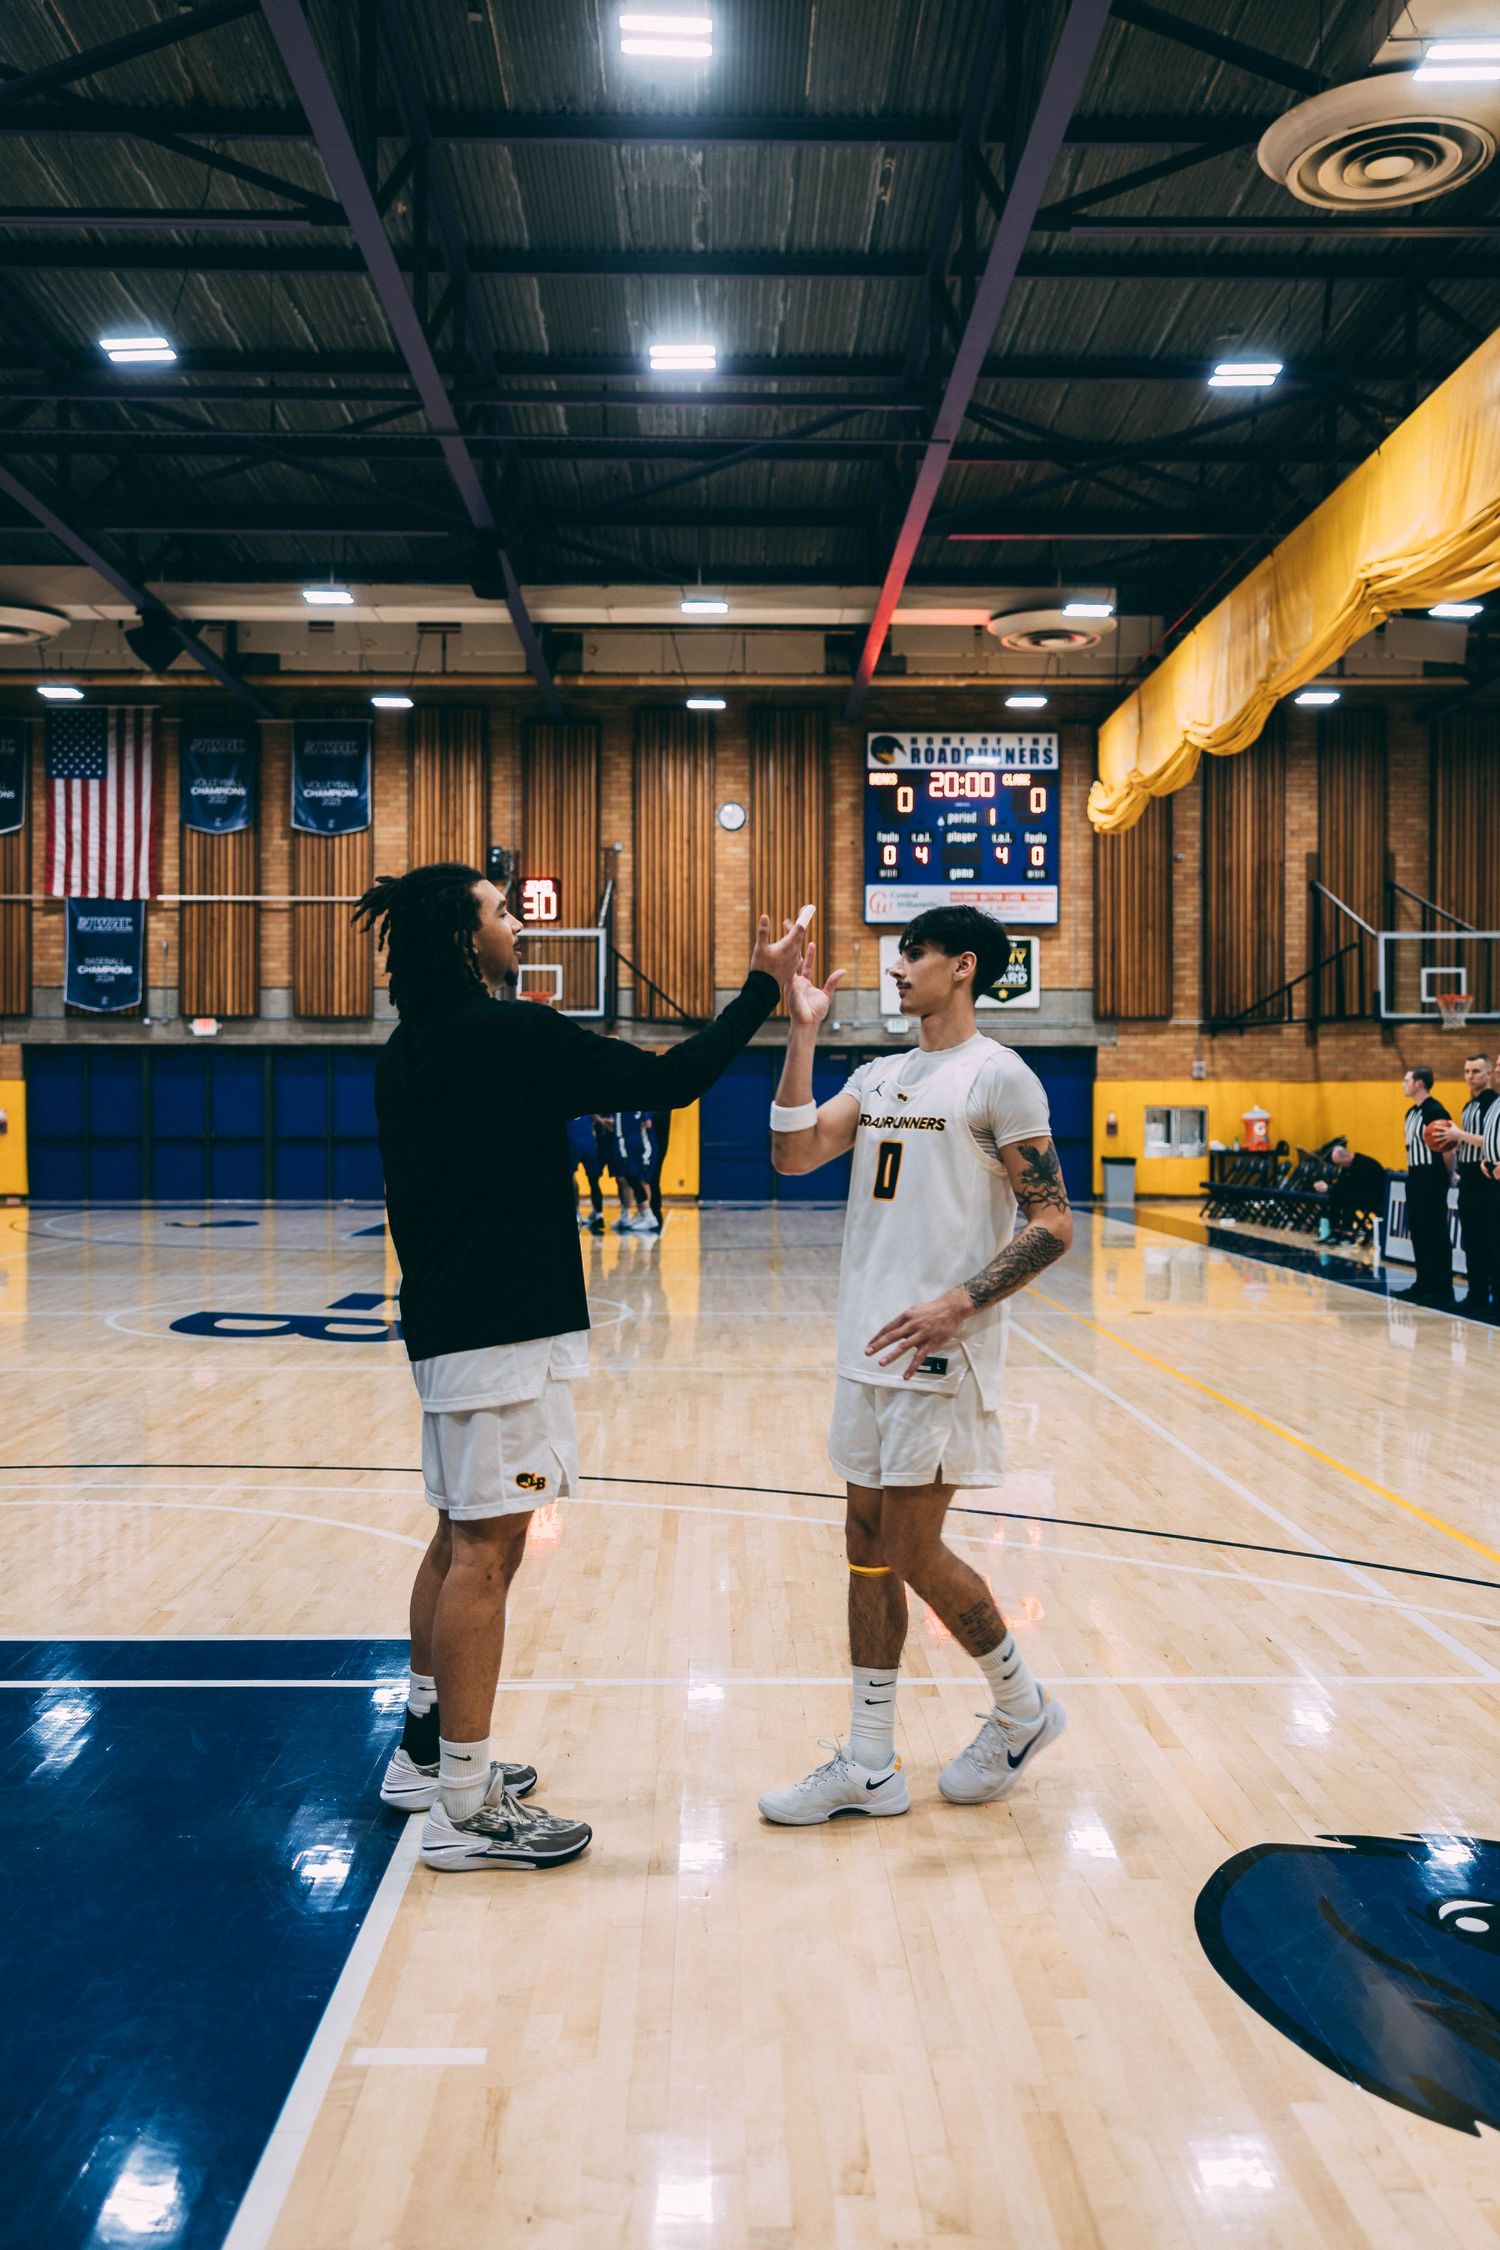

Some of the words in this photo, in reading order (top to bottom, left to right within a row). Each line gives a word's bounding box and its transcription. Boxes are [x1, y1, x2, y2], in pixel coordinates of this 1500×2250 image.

[910, 736, 965, 746] HOME
[981, 736, 1002, 746] OF
[1018, 736, 1053, 746] THE
[910, 747, 1053, 765] ROADRUNNERS
[190, 786, 247, 796] CHAMPIONS
[303, 788, 359, 798] CHAMPIONS
[928, 771, 995, 798] 20:00
[897, 786, 914, 813] 0
[1030, 787, 1046, 814] 0
[947, 811, 977, 826] period
[989, 807, 996, 826] 1
[946, 831, 978, 845] player
[883, 844, 897, 866] 0
[915, 846, 928, 865] 4
[995, 846, 1008, 865] 4
[1031, 845, 1045, 866] 0
[949, 868, 974, 881] game
[522, 891, 557, 920] 30
[77, 965, 133, 975] CHAMPIONS
[872, 1139, 904, 1202] 0
